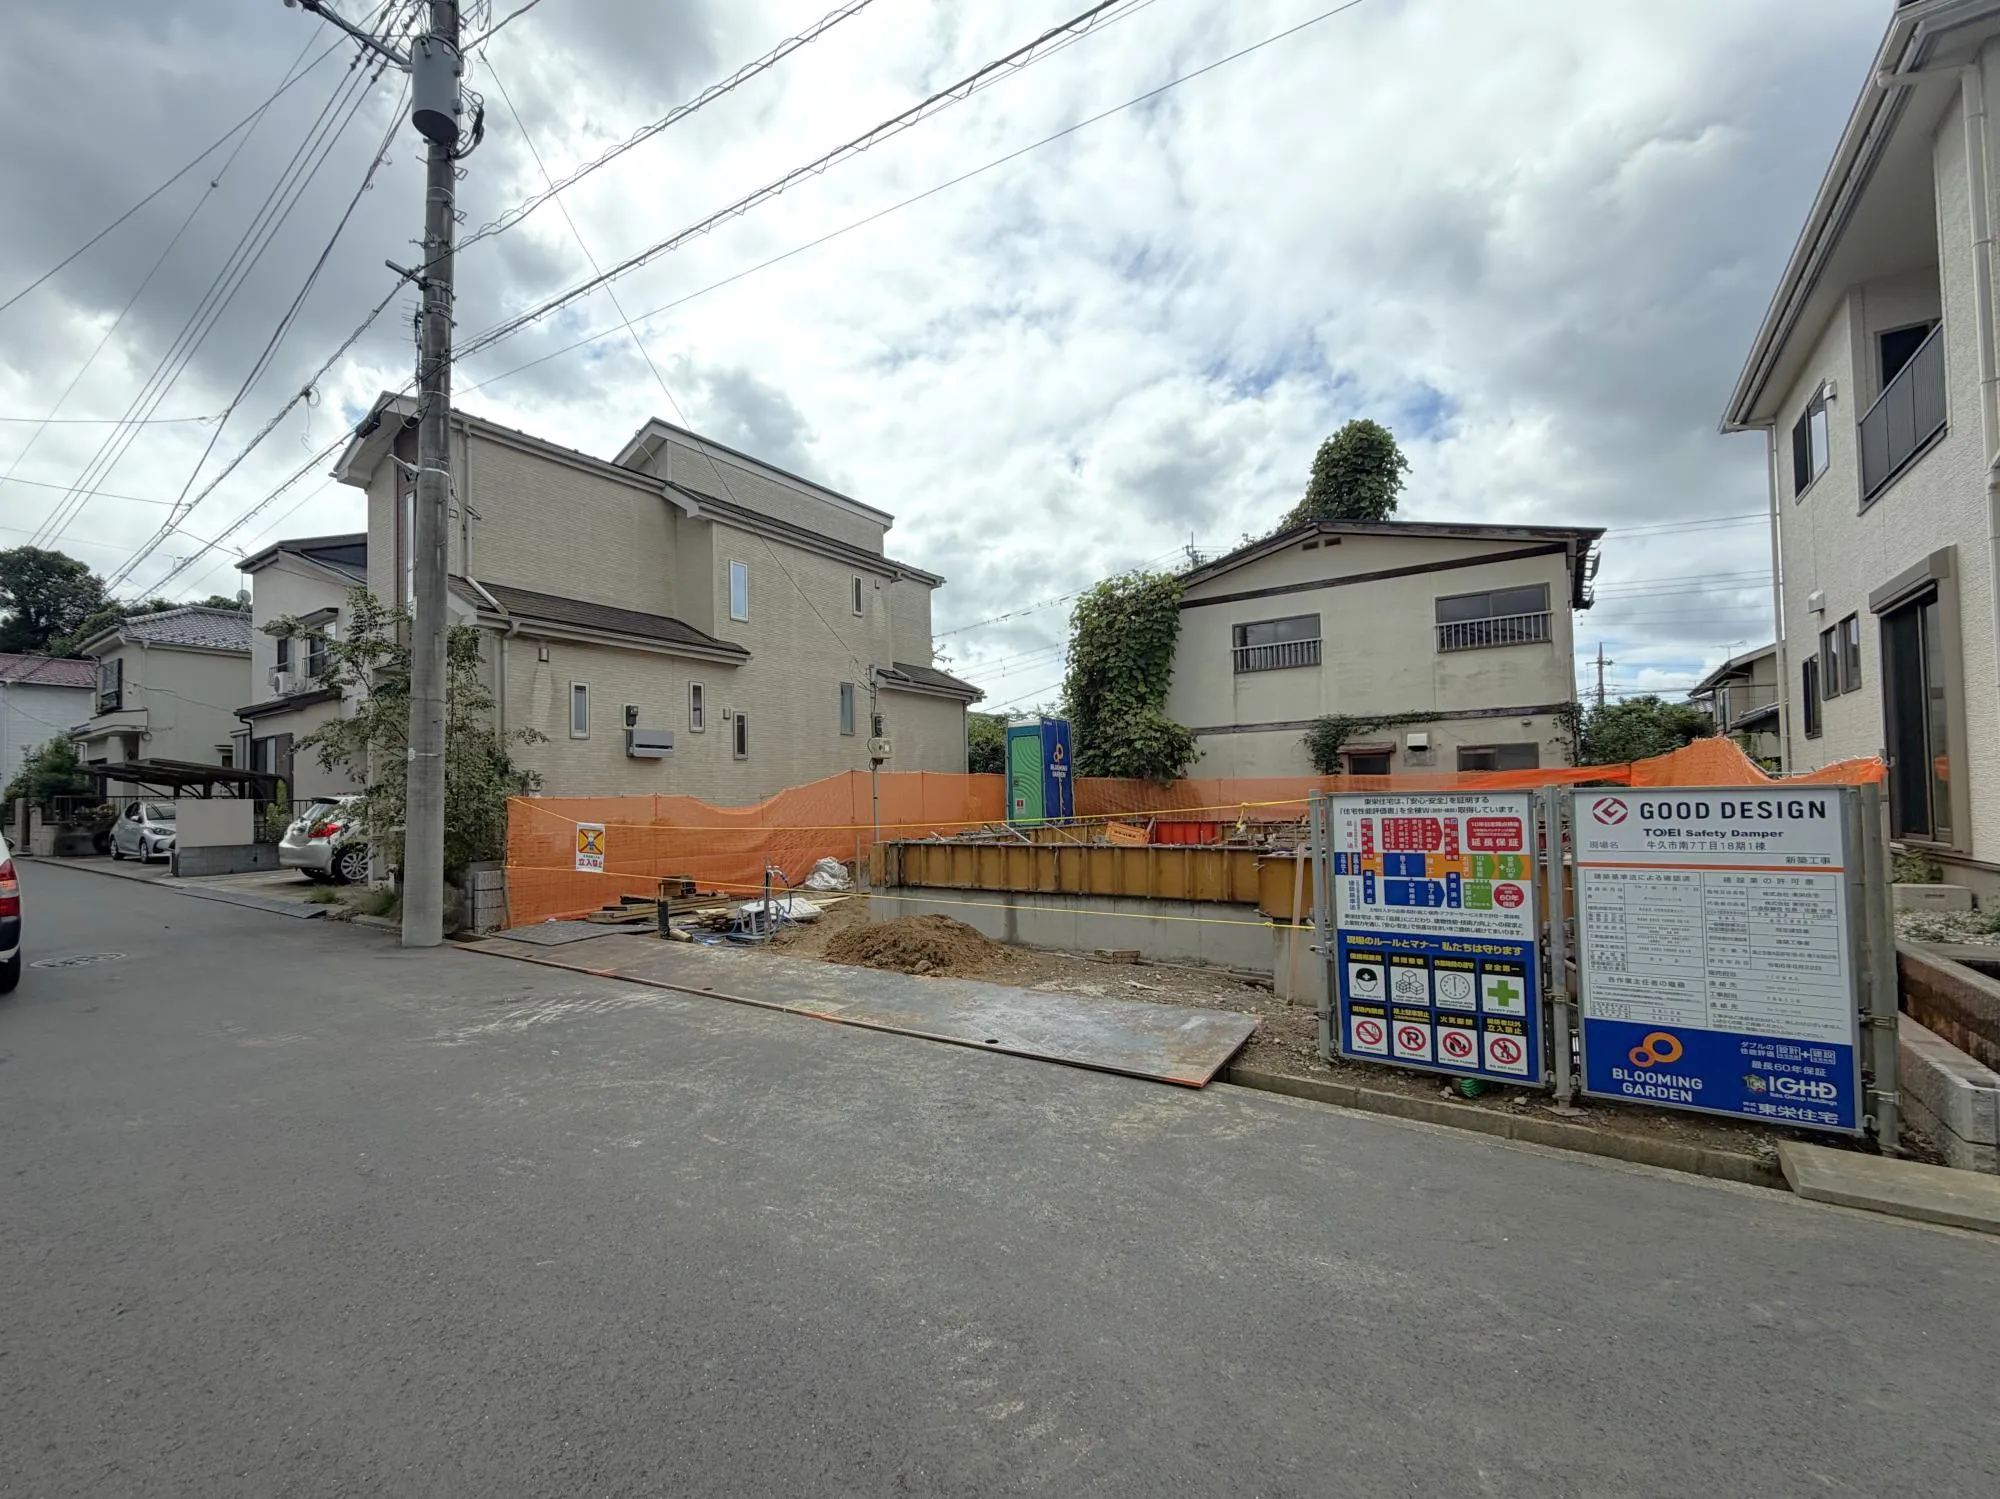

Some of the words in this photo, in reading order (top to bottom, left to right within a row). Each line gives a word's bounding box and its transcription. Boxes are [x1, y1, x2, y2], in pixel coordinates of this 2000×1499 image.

[1640, 801, 1710, 820] GOOD
[1721, 800, 1826, 819] DESIGN
[1686, 828, 1727, 839] Safety
[1731, 829, 1784, 839] Damper
[1589, 841, 1619, 849] 現場名
[1785, 855, 1832, 865] 新築工事
[1594, 873, 1690, 882] 建築基準法による確認済
[1723, 876, 1814, 886] 建設業の許可票
[1346, 935, 1439, 949] 現場のルールとマナー
[1442, 941, 1524, 956] 私たちは守ります
[1484, 963, 1521, 972] 安全第一
[1487, 1025, 1523, 1035] 立入禁止
[1612, 1067, 1703, 1090] BLOOMING
[1622, 1081, 1693, 1102] GARDEN
[1758, 1102, 1840, 1125] 東栄住宅
